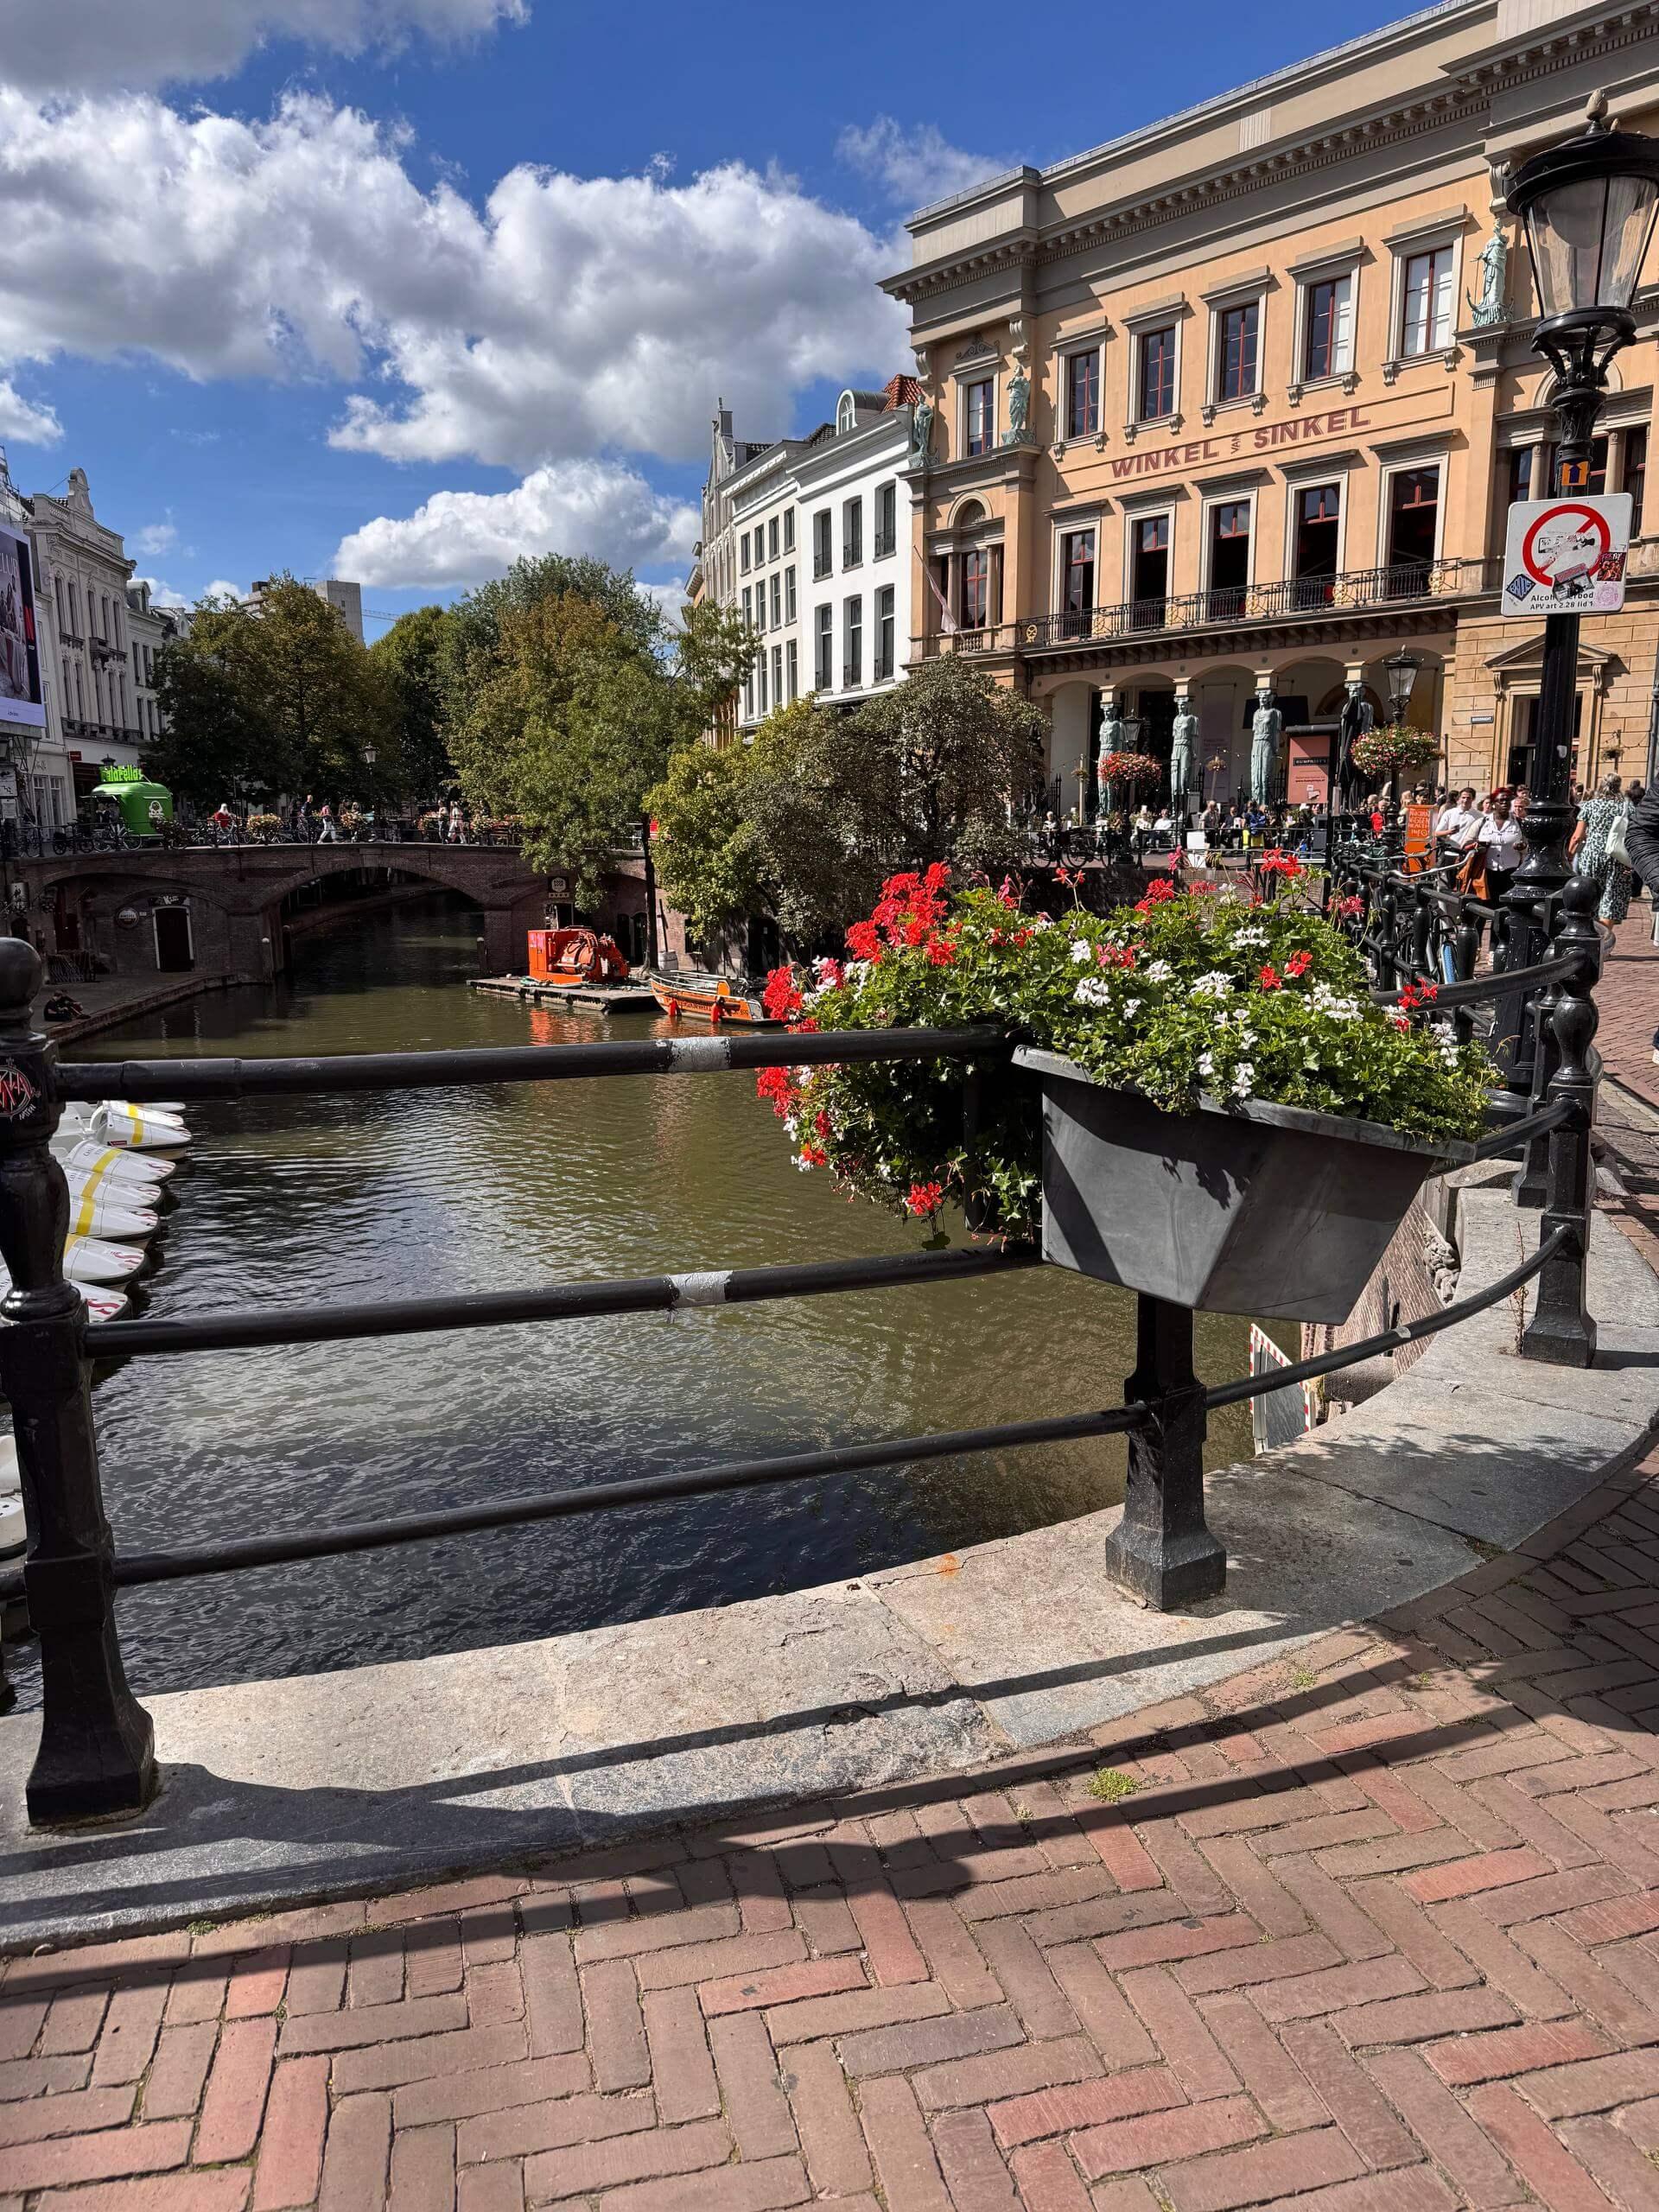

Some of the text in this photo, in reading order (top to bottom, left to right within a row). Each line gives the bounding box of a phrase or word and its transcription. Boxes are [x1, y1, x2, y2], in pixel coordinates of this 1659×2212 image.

[1111, 442, 1219, 478] WINKEL
[1254, 407, 1370, 448] SINKEL
[1531, 591, 1594, 601] Alcohrbod
